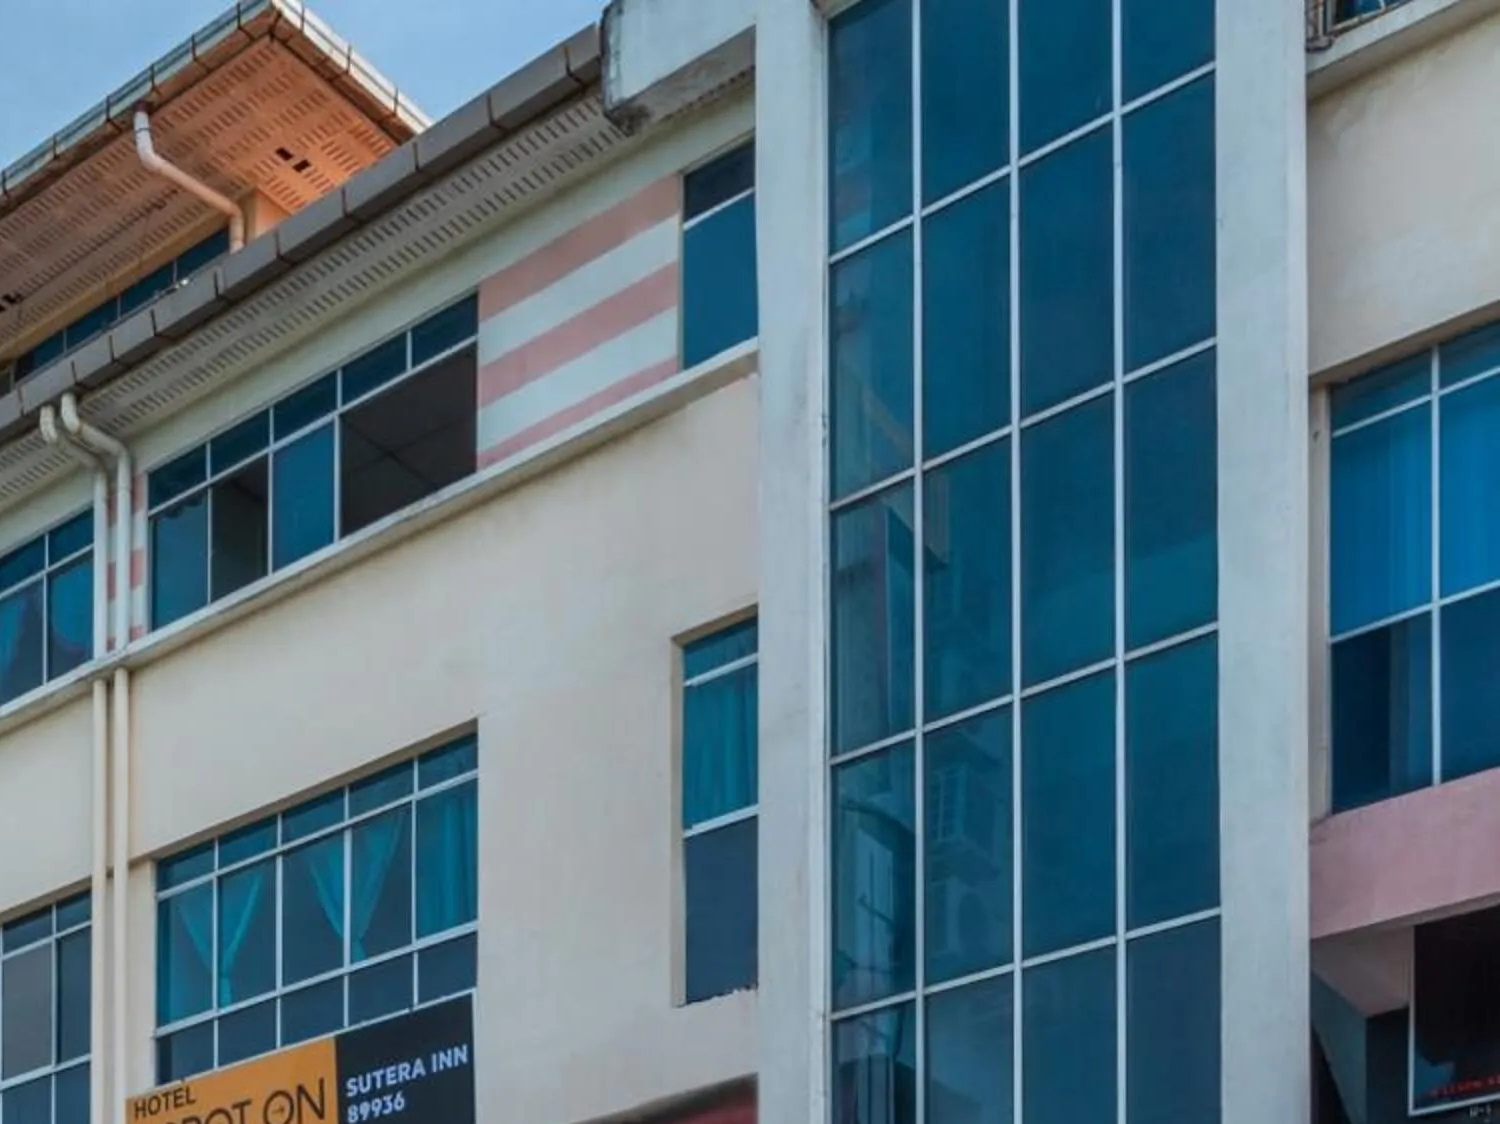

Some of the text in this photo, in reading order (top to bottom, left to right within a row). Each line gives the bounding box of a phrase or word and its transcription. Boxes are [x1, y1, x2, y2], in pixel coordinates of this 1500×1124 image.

[346, 1044, 468, 1097] SUTERA INN
[134, 1086, 196, 1120] HOTEL
[347, 1090, 405, 1124] 89936
